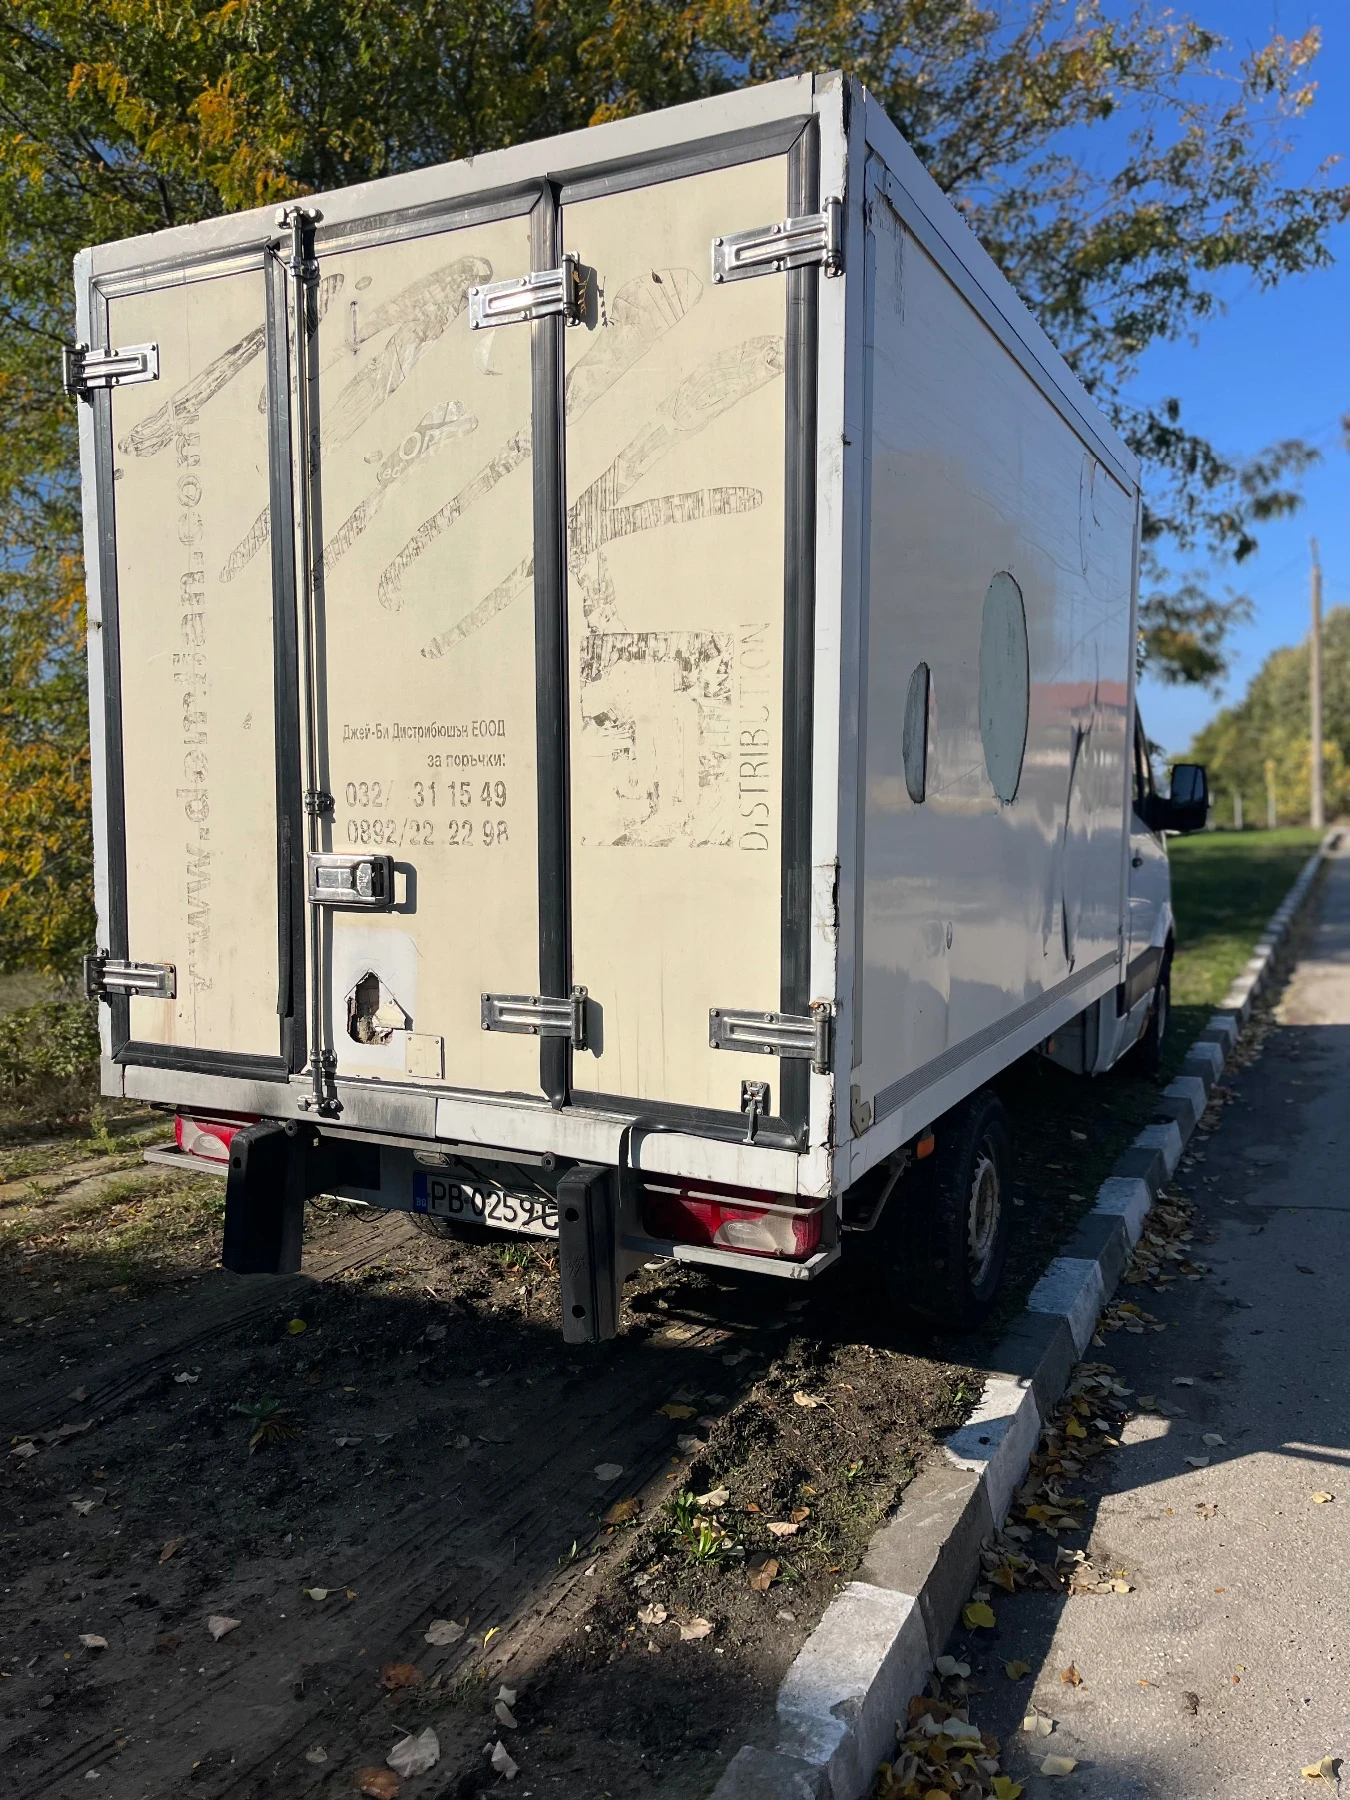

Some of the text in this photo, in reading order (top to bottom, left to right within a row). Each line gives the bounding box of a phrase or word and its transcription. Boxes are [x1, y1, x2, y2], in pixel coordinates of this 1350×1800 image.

[343, 723, 389, 743] Джей-Би
[471, 719, 506, 739] ЕООД
[427, 753, 506, 771] за поръчки:
[345, 780, 507, 810] 032/ 31 15 49
[347, 818, 435, 847] 0892/22
[448, 820, 474, 847] 22
[416, 1197, 427, 1207] BG
[431, 1181, 464, 1213] PB
